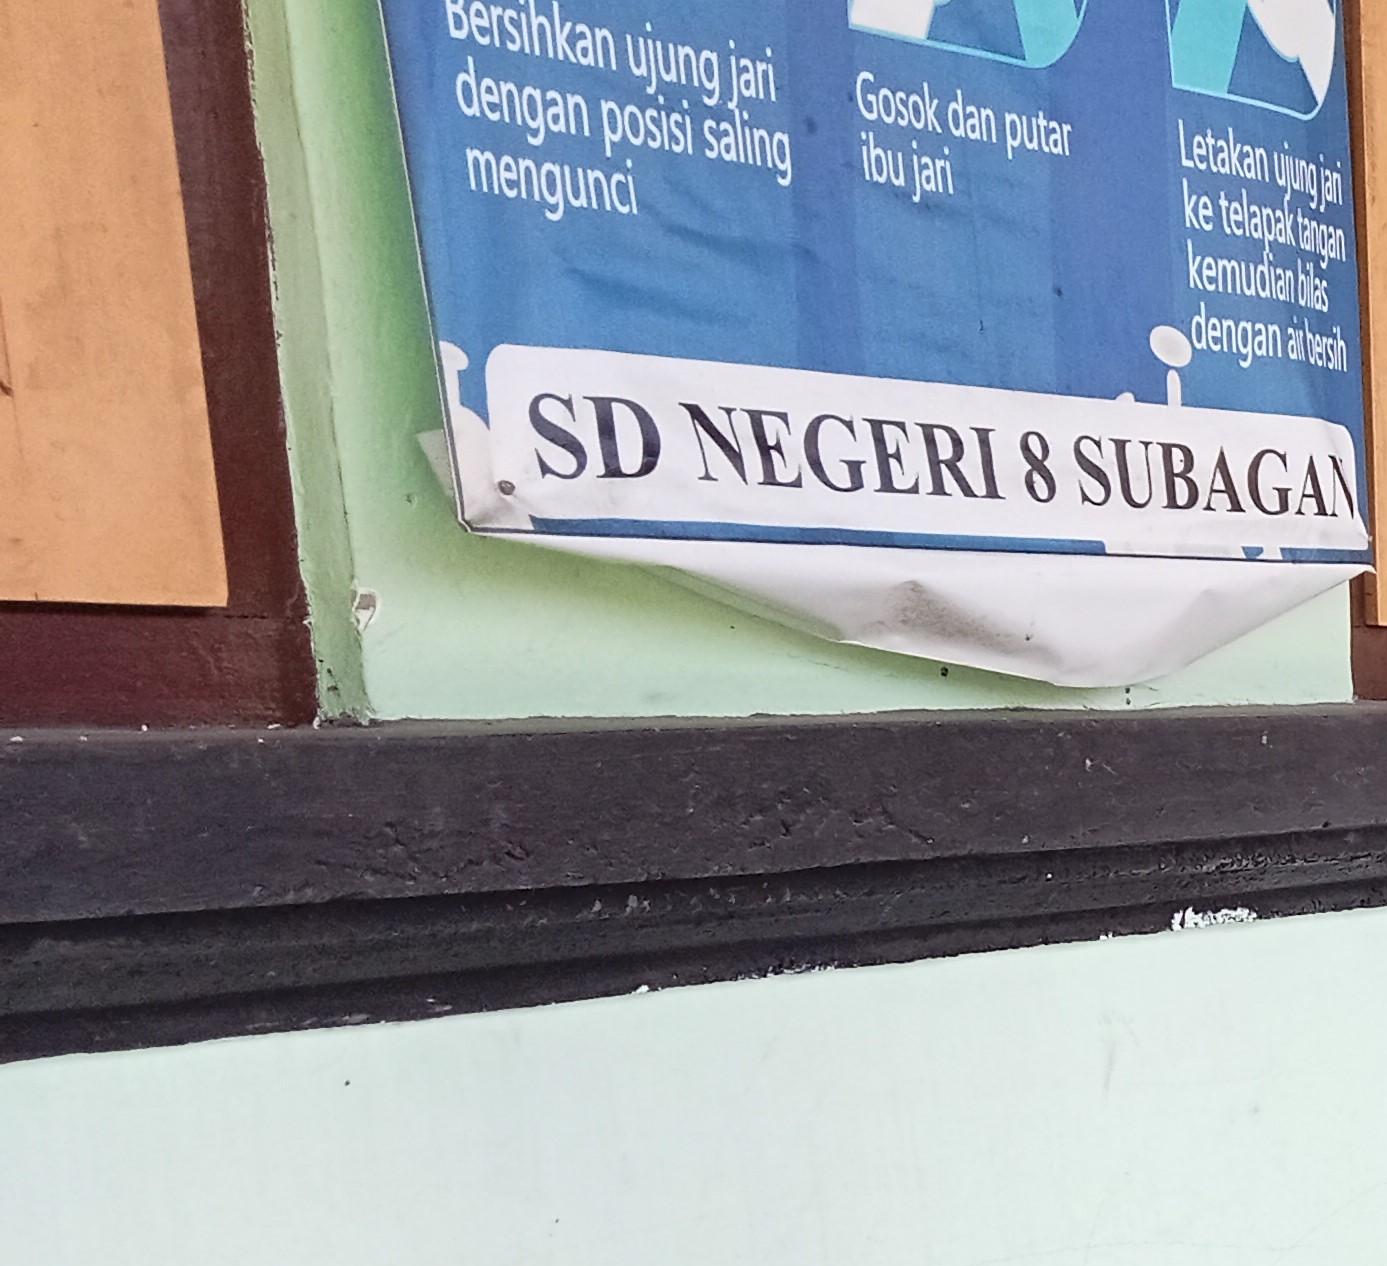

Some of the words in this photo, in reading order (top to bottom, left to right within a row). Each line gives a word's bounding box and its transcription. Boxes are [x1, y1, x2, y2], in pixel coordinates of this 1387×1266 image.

[445, 0, 617, 70] Bersihkan
[626, 22, 721, 107] ujung
[727, 39, 777, 109] jari
[456, 55, 591, 146] dengan
[601, 95, 693, 158] posisi
[704, 108, 793, 187] saling
[855, 71, 943, 134] Gosok
[948, 89, 998, 143] dan
[1004, 110, 1073, 160] putar
[465, 147, 639, 222] mengunci
[860, 131, 906, 187] ibu
[911, 139, 954, 203] jari
[1178, 119, 1270, 183] Letakan
[1273, 141, 1318, 209] ujung
[1319, 154, 1343, 212] jari
[1182, 177, 1215, 232] ke
[1219, 188, 1296, 252] telapak
[1297, 207, 1347, 270] tangan
[1186, 238, 1295, 304] kemudian
[1297, 258, 1330, 313] bilas
[1191, 301, 1283, 369] dengan
[1287, 315, 1305, 362] air
[1303, 317, 1348, 373] bersih
[528, 392, 662, 481] SD
[678, 400, 1006, 501] NEGERI
[1019, 430, 1057, 504] 8
[1073, 434, 1356, 520] SUBAGAN
